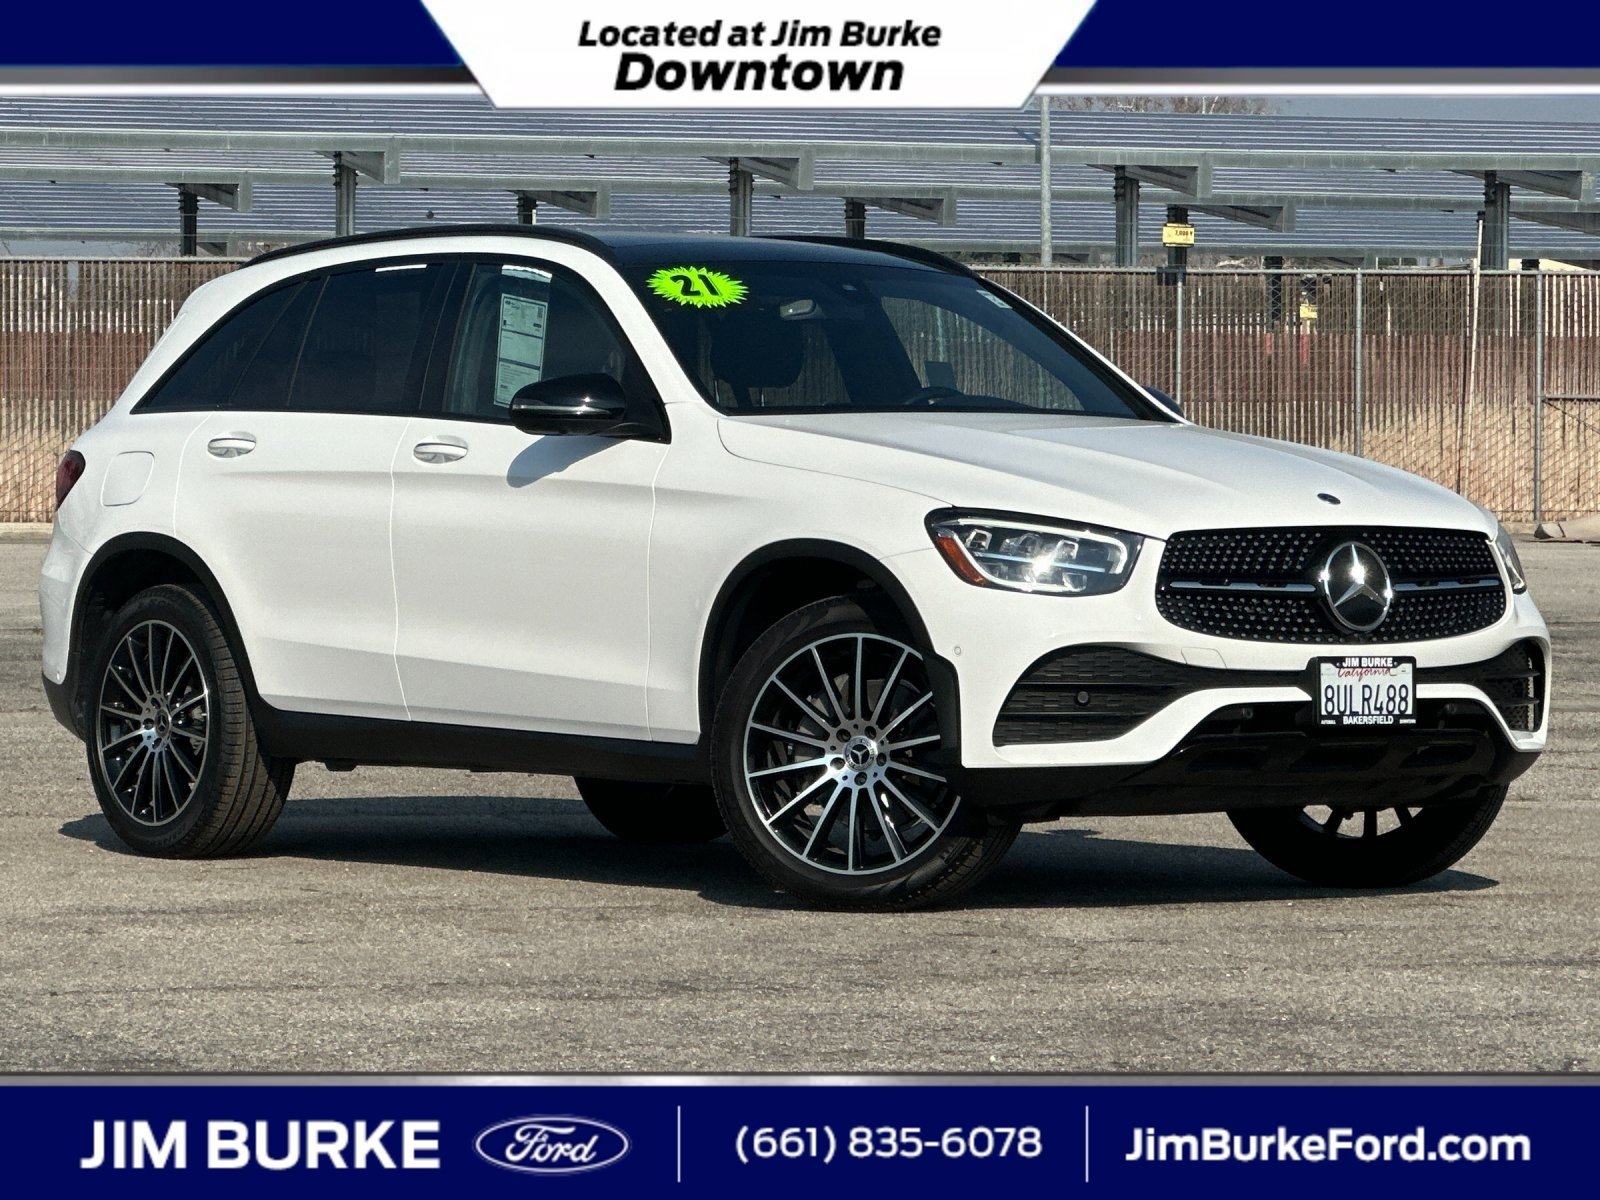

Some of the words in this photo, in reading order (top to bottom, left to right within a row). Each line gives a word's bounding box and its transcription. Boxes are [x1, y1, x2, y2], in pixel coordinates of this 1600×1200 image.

[669, 274, 720, 297] 21
[1342, 657, 1359, 667] JIM
[1361, 657, 1393, 667] BURKE
[1337, 667, 1396, 682] California
[1324, 684, 1409, 715] 8ULR488
[1342, 716, 1394, 725] BAKERSFIELD
